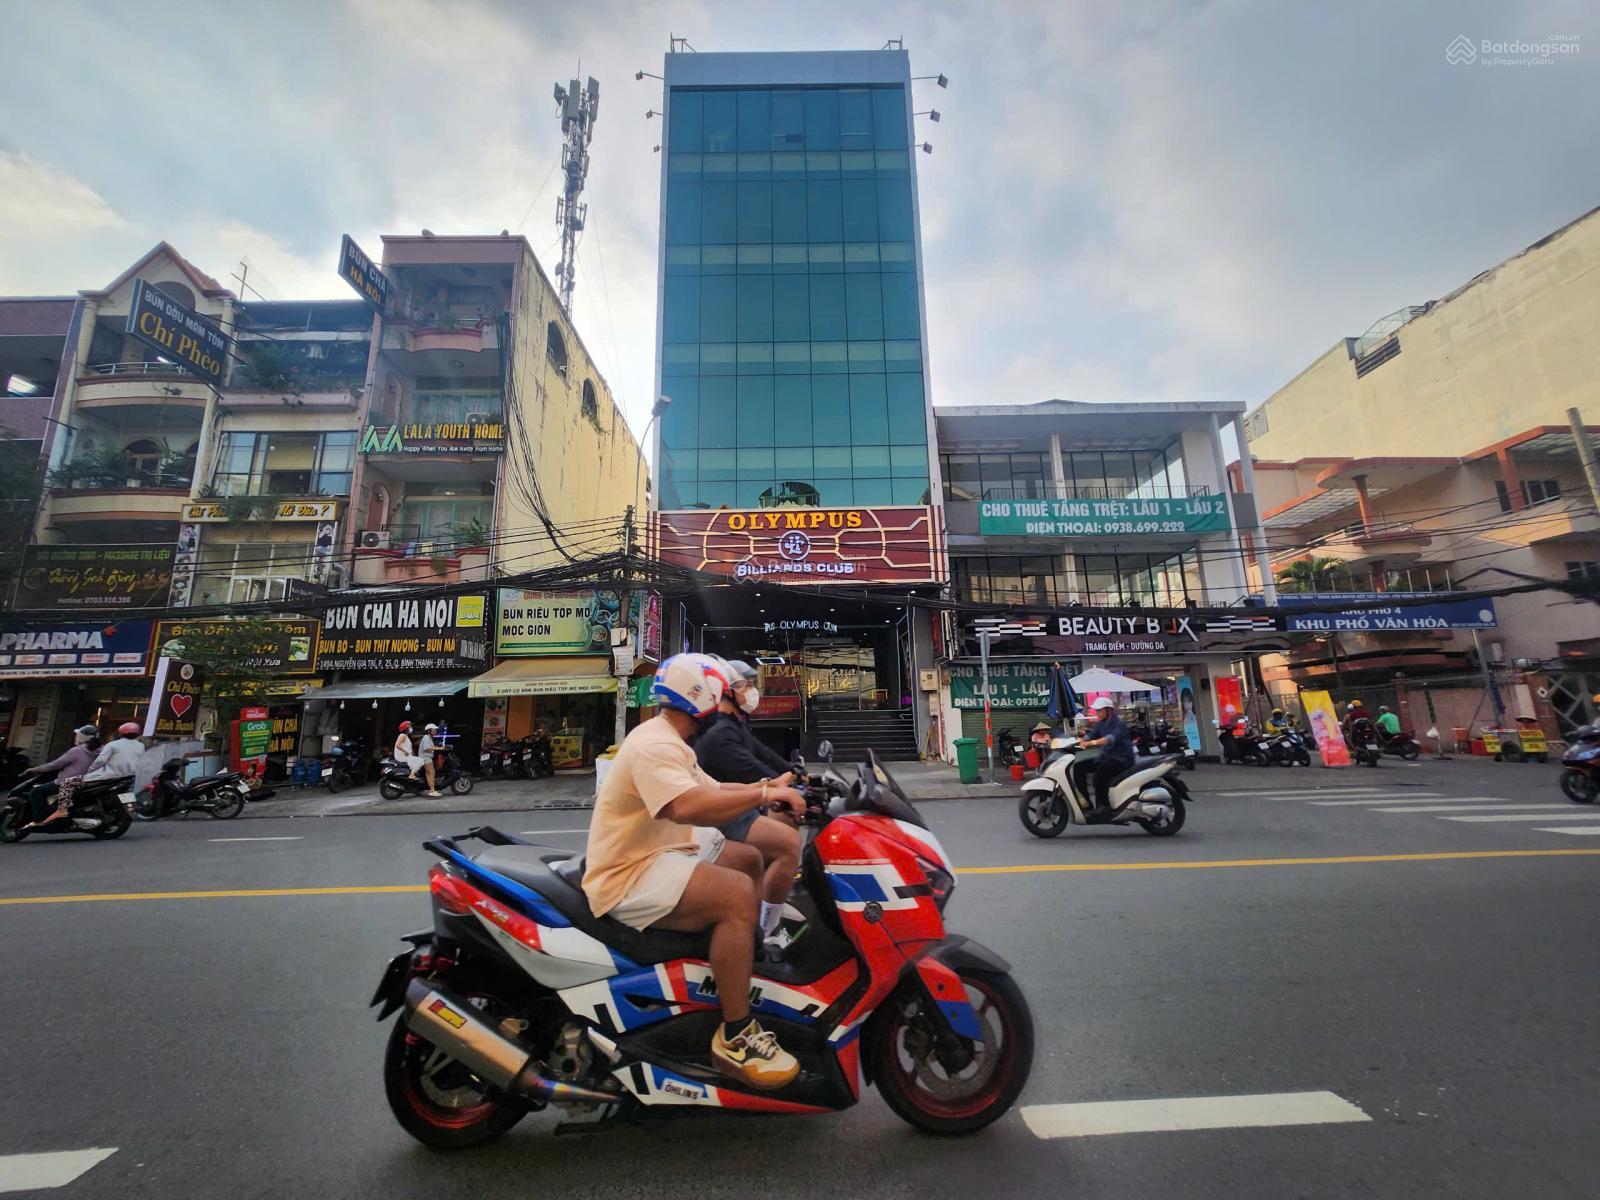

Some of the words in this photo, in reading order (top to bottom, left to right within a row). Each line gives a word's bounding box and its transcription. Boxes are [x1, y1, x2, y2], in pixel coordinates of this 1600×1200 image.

[144, 288, 165, 311] BÚN
[139, 311, 176, 348] Chí
[175, 333, 220, 376] Phèo
[403, 423, 432, 439] LALA
[435, 423, 470, 439] YOUTH
[474, 423, 504, 439] HOME
[982, 503, 1010, 517] CHO
[1014, 500, 1049, 517] THUÊ
[1093, 500, 1129, 519] TRỆT:
[1164, 502, 1171, 515] 1
[1215, 501, 1225, 514] 2
[728, 511, 863, 530] OLYMPUS
[1026, 522, 1055, 534] ĐIỆN
[1104, 521, 1185, 533] 0938.699.222
[737, 563, 812, 577] BILLIARDS
[816, 562, 855, 574] CLUB
[503, 605, 523, 619] BÚN
[527, 606, 550, 619] RIÊU
[780, 620, 819, 630] OLYMPUS
[1058, 616, 1137, 636] BEAUTY
[1295, 619, 1330, 630] KHU
[1335, 614, 1369, 630] PHỐ
[1374, 616, 1409, 629] VĂN
[1413, 615, 1449, 629] HÓA
[0, 631, 104, 650] PHARMA
[1085, 642, 1107, 652] TRANG
[1155, 641, 1165, 650] DA
[950, 666, 974, 678] CHO
[1002, 684, 1008, 695] 1
[247, 721, 267, 731] Grab
